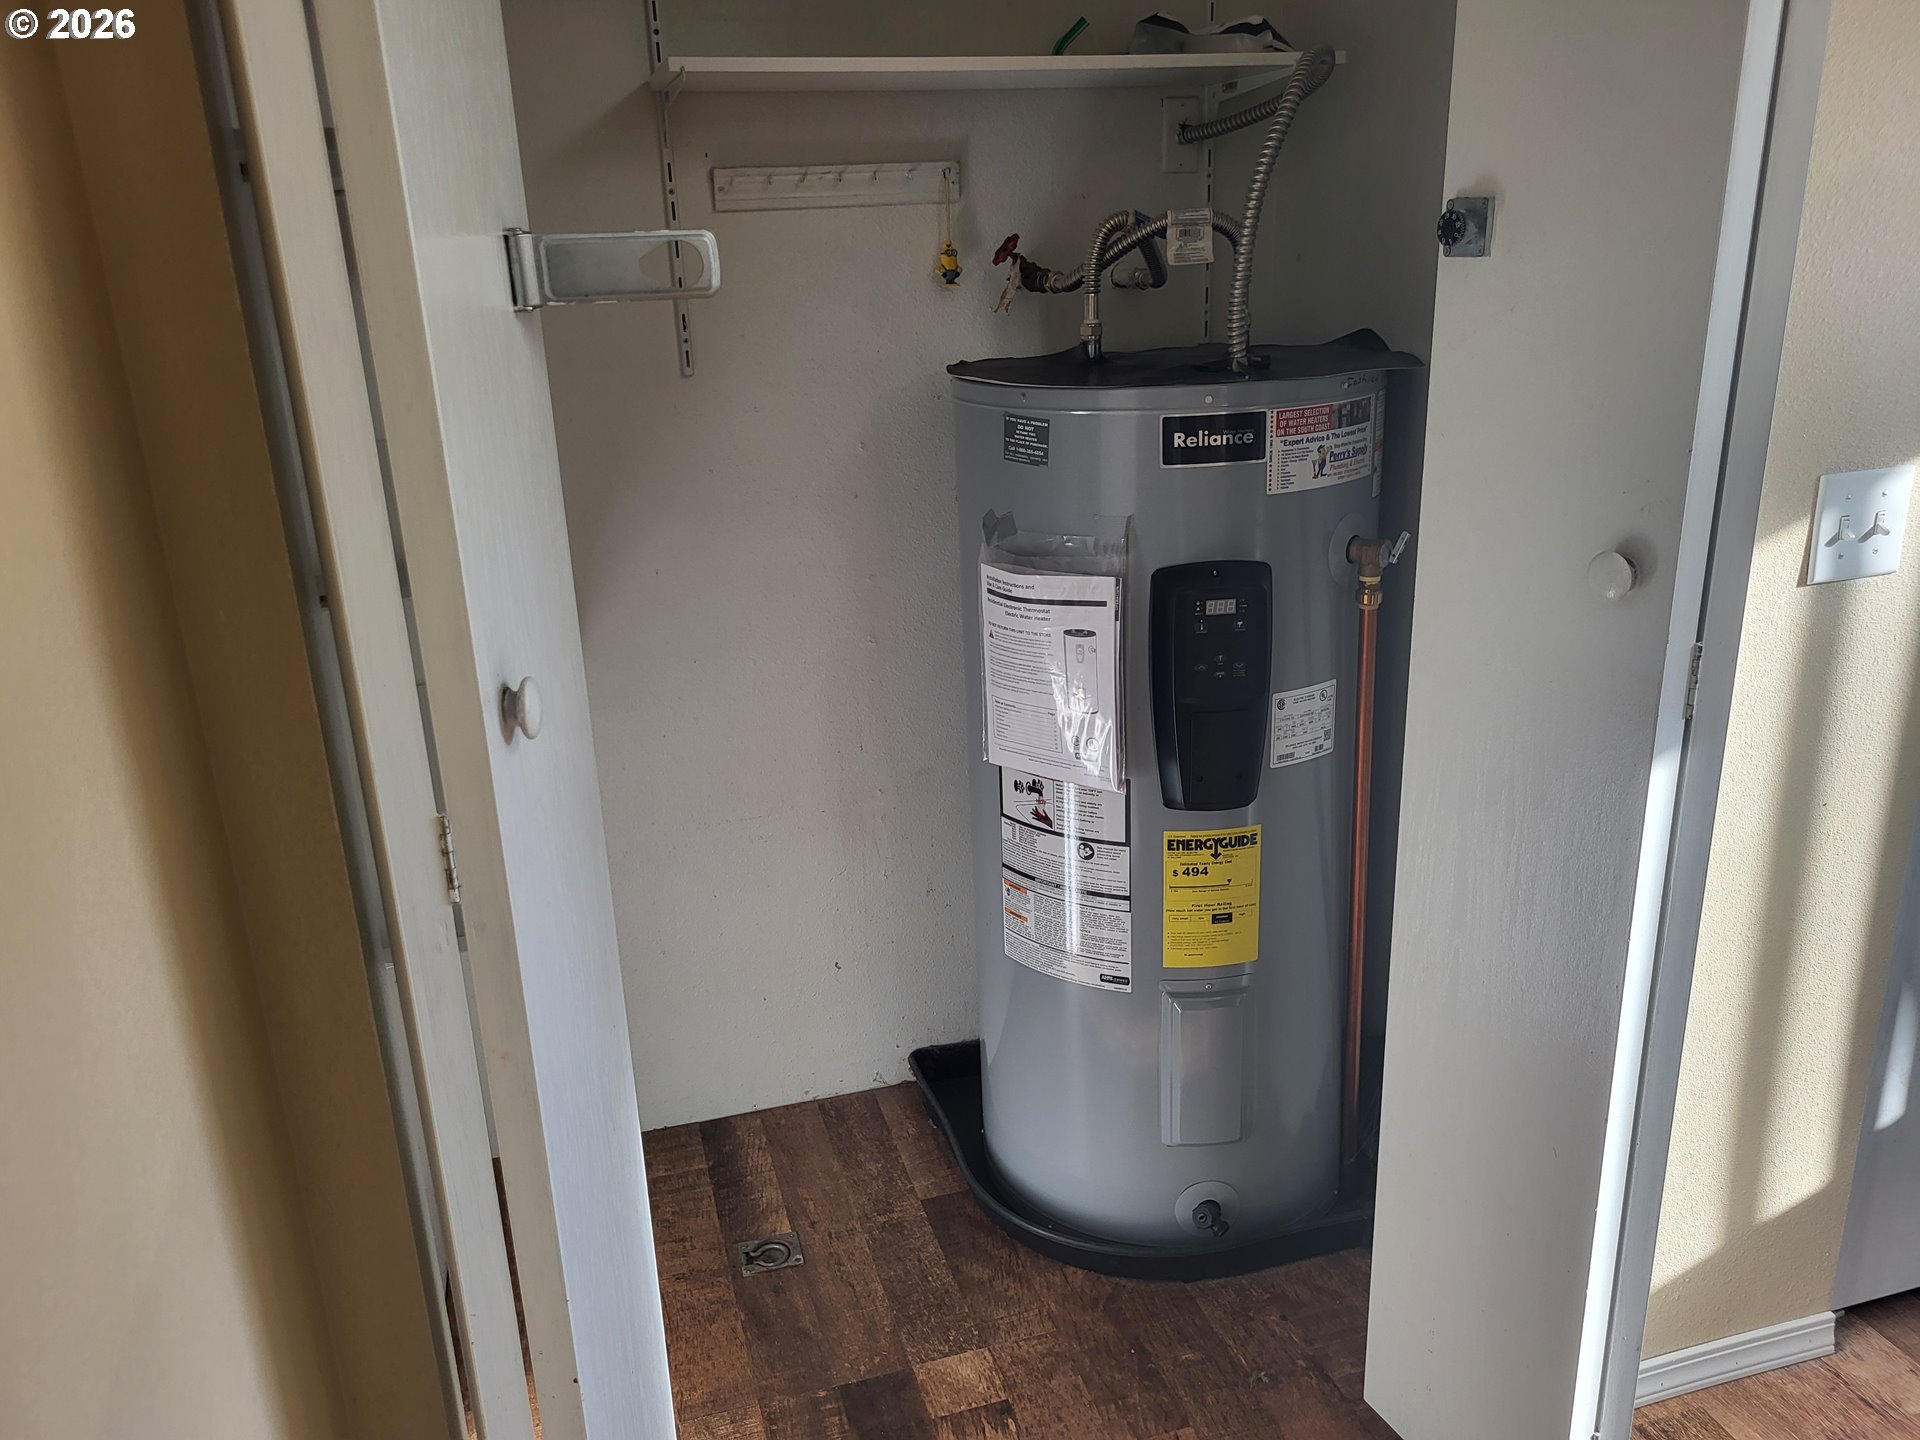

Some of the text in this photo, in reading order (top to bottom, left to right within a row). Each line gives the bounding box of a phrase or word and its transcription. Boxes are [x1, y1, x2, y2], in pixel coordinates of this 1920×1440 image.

[1279, 407, 1330, 420] LARGEST SELECTION
[1277, 422, 1330, 436] ON THE SOUTH COAST
[1280, 415, 1329, 428] OF WATER HEATERS
[1173, 430, 1254, 448] Reliance
[1305, 434, 1326, 444] Advice
[1331, 432, 1341, 440] The
[1342, 428, 1356, 438] Lowest
[1329, 448, 1350, 462] Perry's
[1352, 444, 1368, 456] Supply
[1167, 833, 1258, 852] ENERGYGUIDE
[1172, 866, 1209, 878] $ 494
